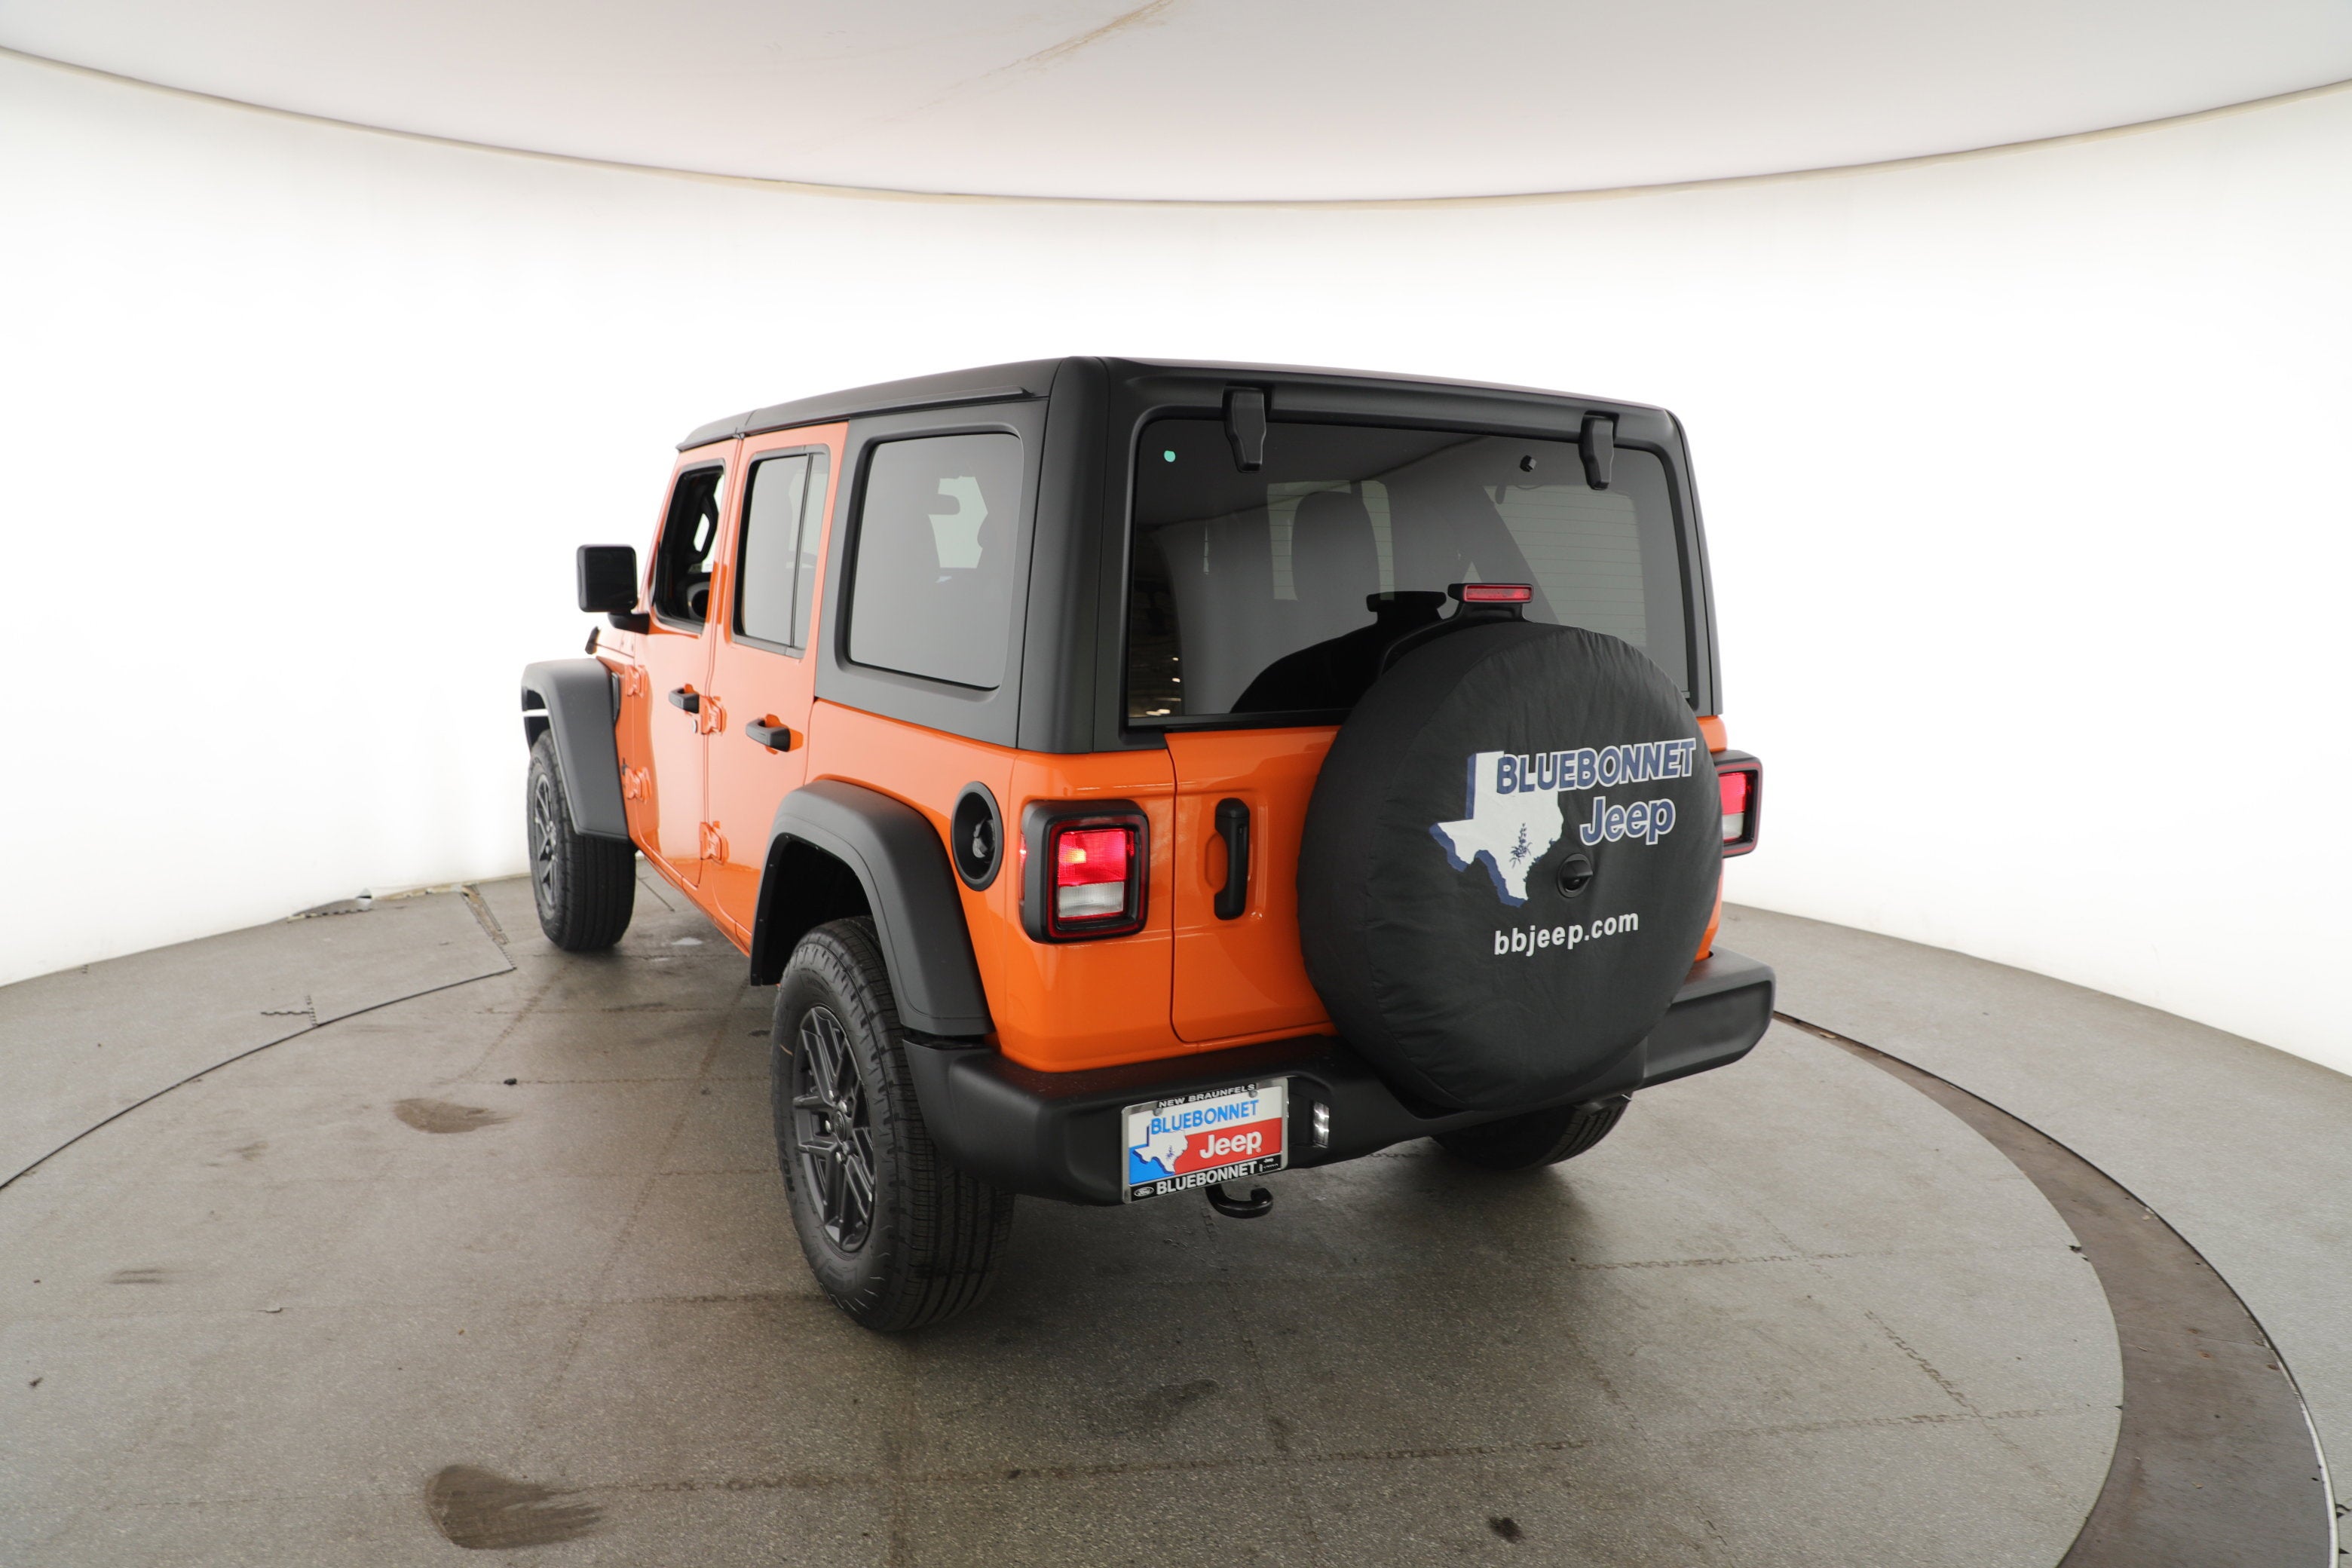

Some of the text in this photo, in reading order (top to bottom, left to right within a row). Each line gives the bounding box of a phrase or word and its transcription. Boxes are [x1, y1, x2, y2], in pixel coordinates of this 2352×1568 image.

[1496, 738, 1696, 795] BLUEBONNET
[1579, 796, 1677, 846] Jeep
[1495, 913, 1639, 957] bbjeep.com
[1159, 1084, 1255, 1108] NEW BRAUNFELS
[1151, 1100, 1260, 1134] BLUEBONNET
[1200, 1131, 1262, 1159] Jeep
[1156, 1162, 1257, 1195] BLUEBONNET
